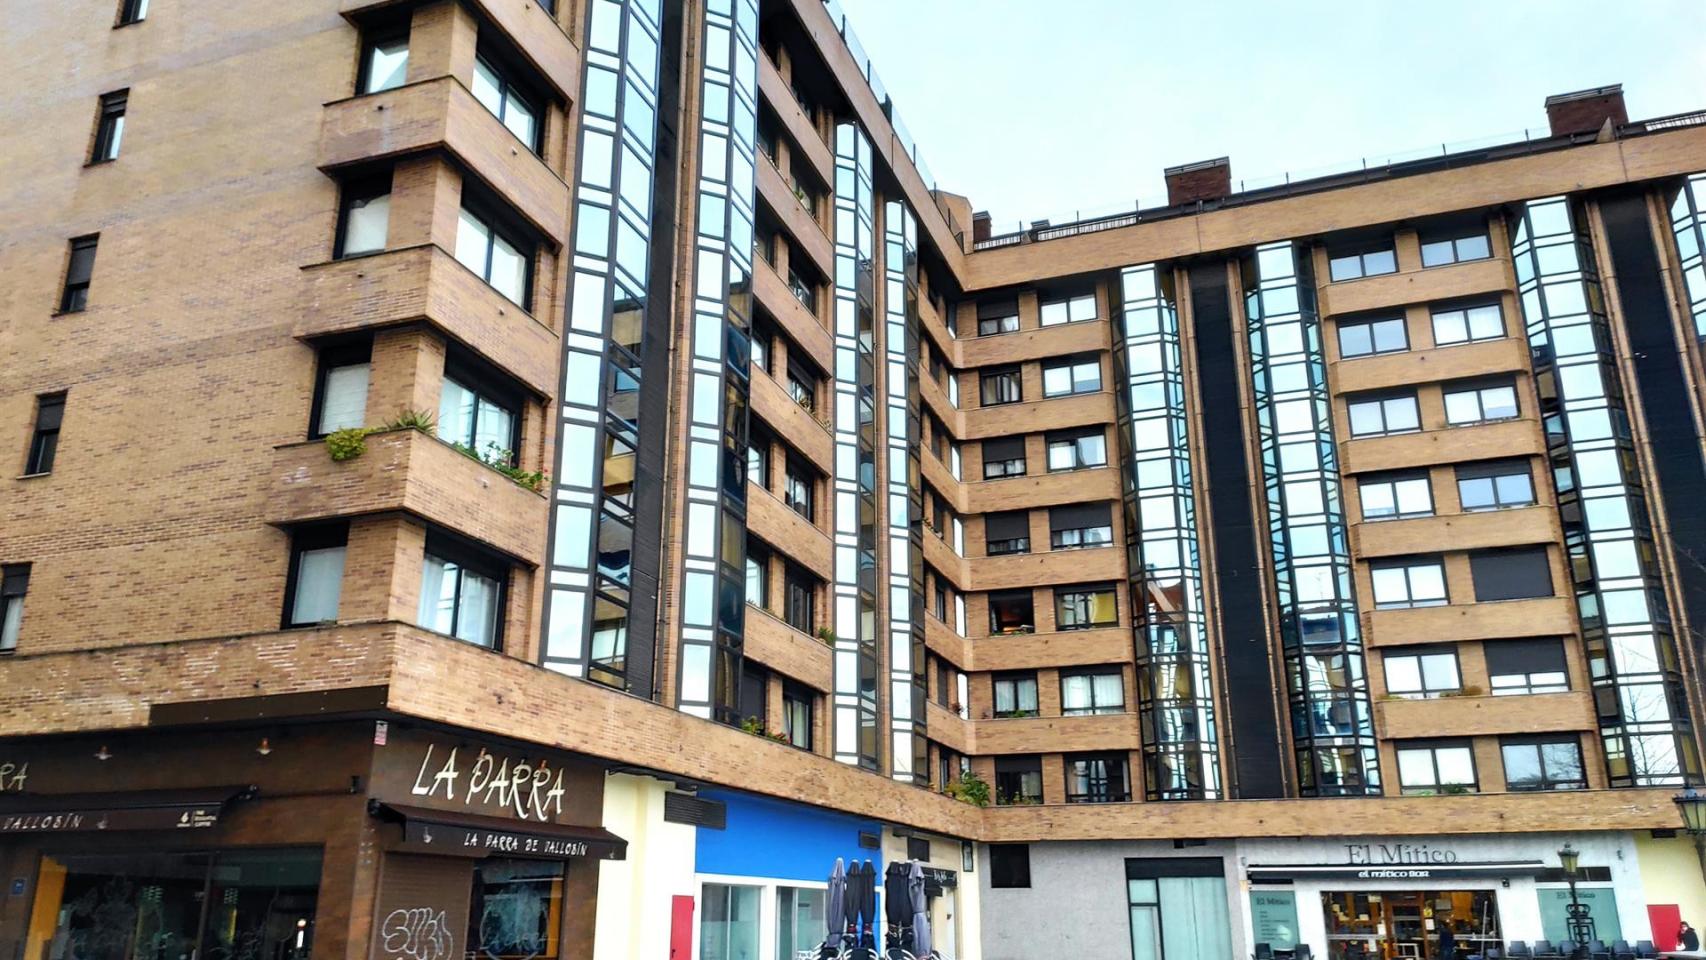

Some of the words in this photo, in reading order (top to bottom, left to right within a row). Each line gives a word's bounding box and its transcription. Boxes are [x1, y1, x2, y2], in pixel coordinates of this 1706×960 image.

[412, 743, 459, 800] LA
[465, 753, 566, 822] PARRA
[463, 833, 478, 847] LA
[485, 834, 519, 851] PARRA
[525, 838, 539, 852] DE
[1344, 844, 1371, 864] El
